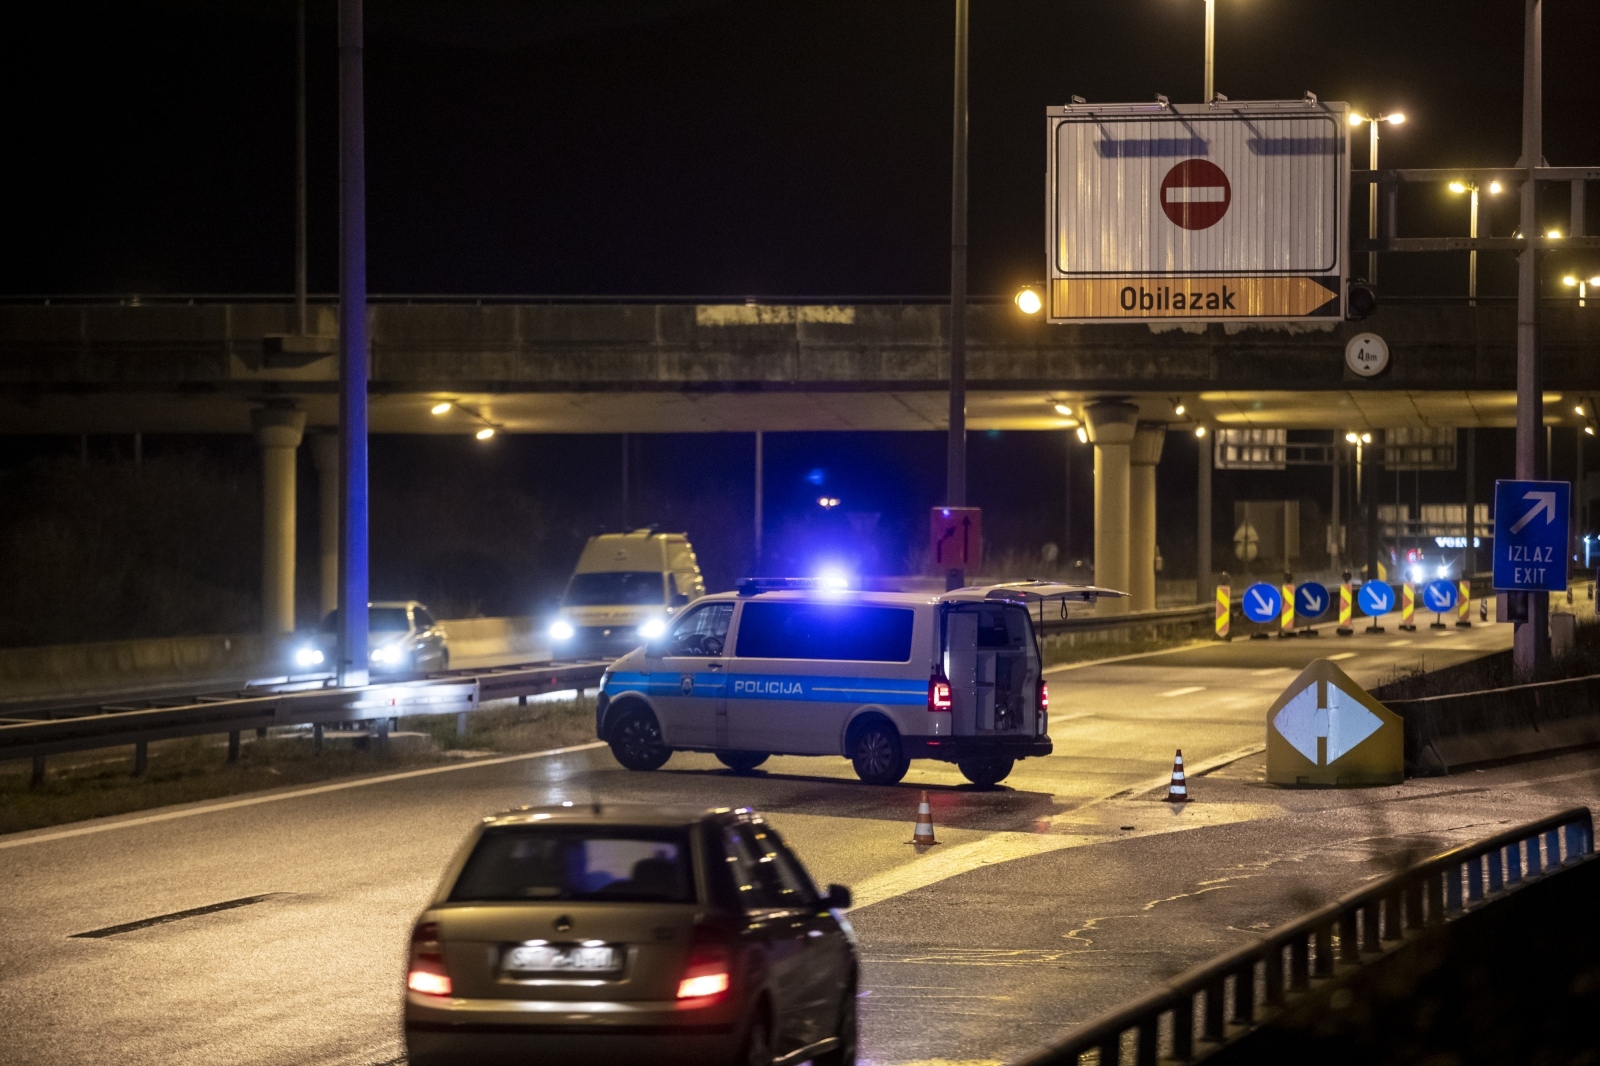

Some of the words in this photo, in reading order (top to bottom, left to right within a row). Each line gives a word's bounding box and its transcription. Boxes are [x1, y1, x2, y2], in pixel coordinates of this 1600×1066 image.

[1120, 285, 1236, 311] Obilazak
[1508, 545, 1553, 563] IZLAZ
[1514, 567, 1546, 584] EXIT
[734, 680, 803, 695] POLICIJA
